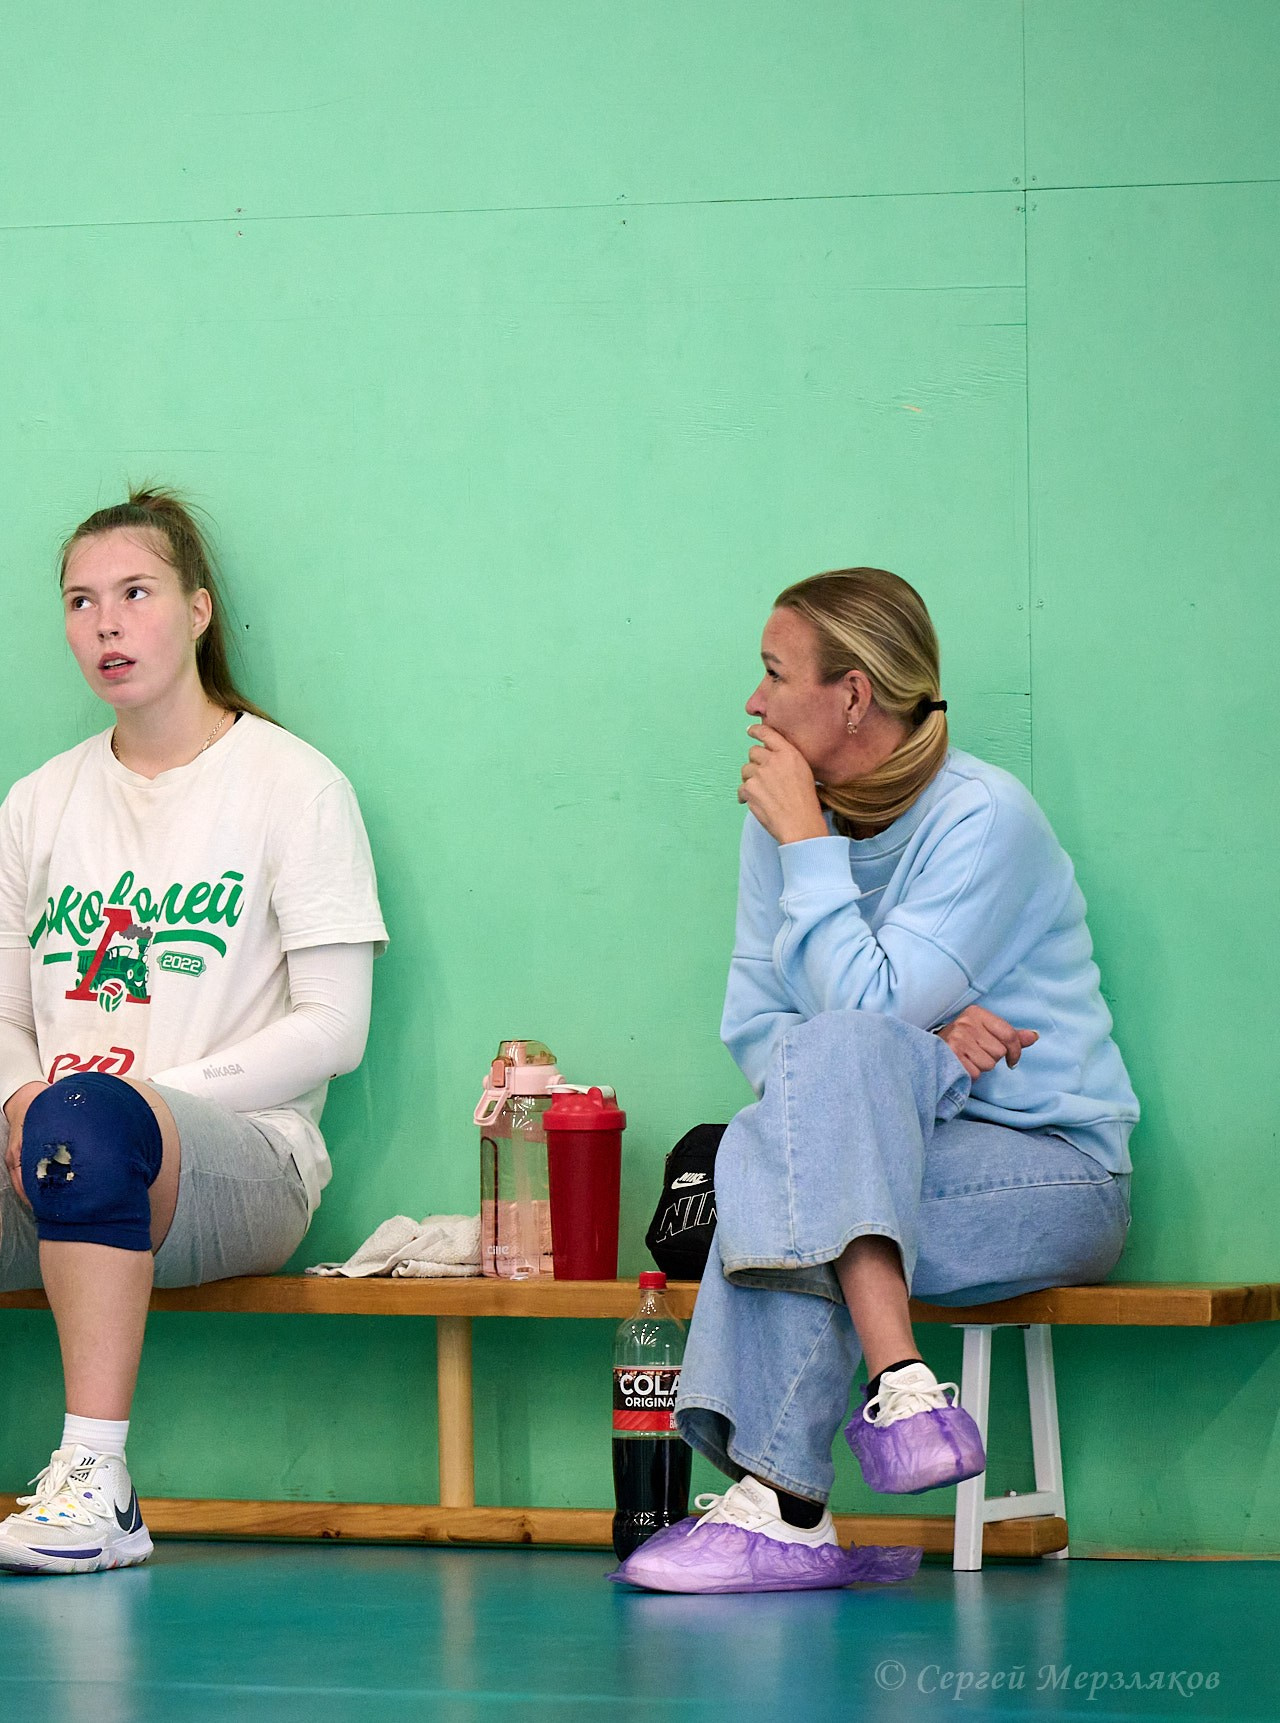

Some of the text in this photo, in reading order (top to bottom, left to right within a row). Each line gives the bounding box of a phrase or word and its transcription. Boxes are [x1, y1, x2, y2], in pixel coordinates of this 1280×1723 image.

[162, 954, 202, 973] 2022
[679, 1171, 707, 1183] NIKE
[619, 1373, 681, 1396] COLA
[624, 1396, 676, 1408] ORIGINA
